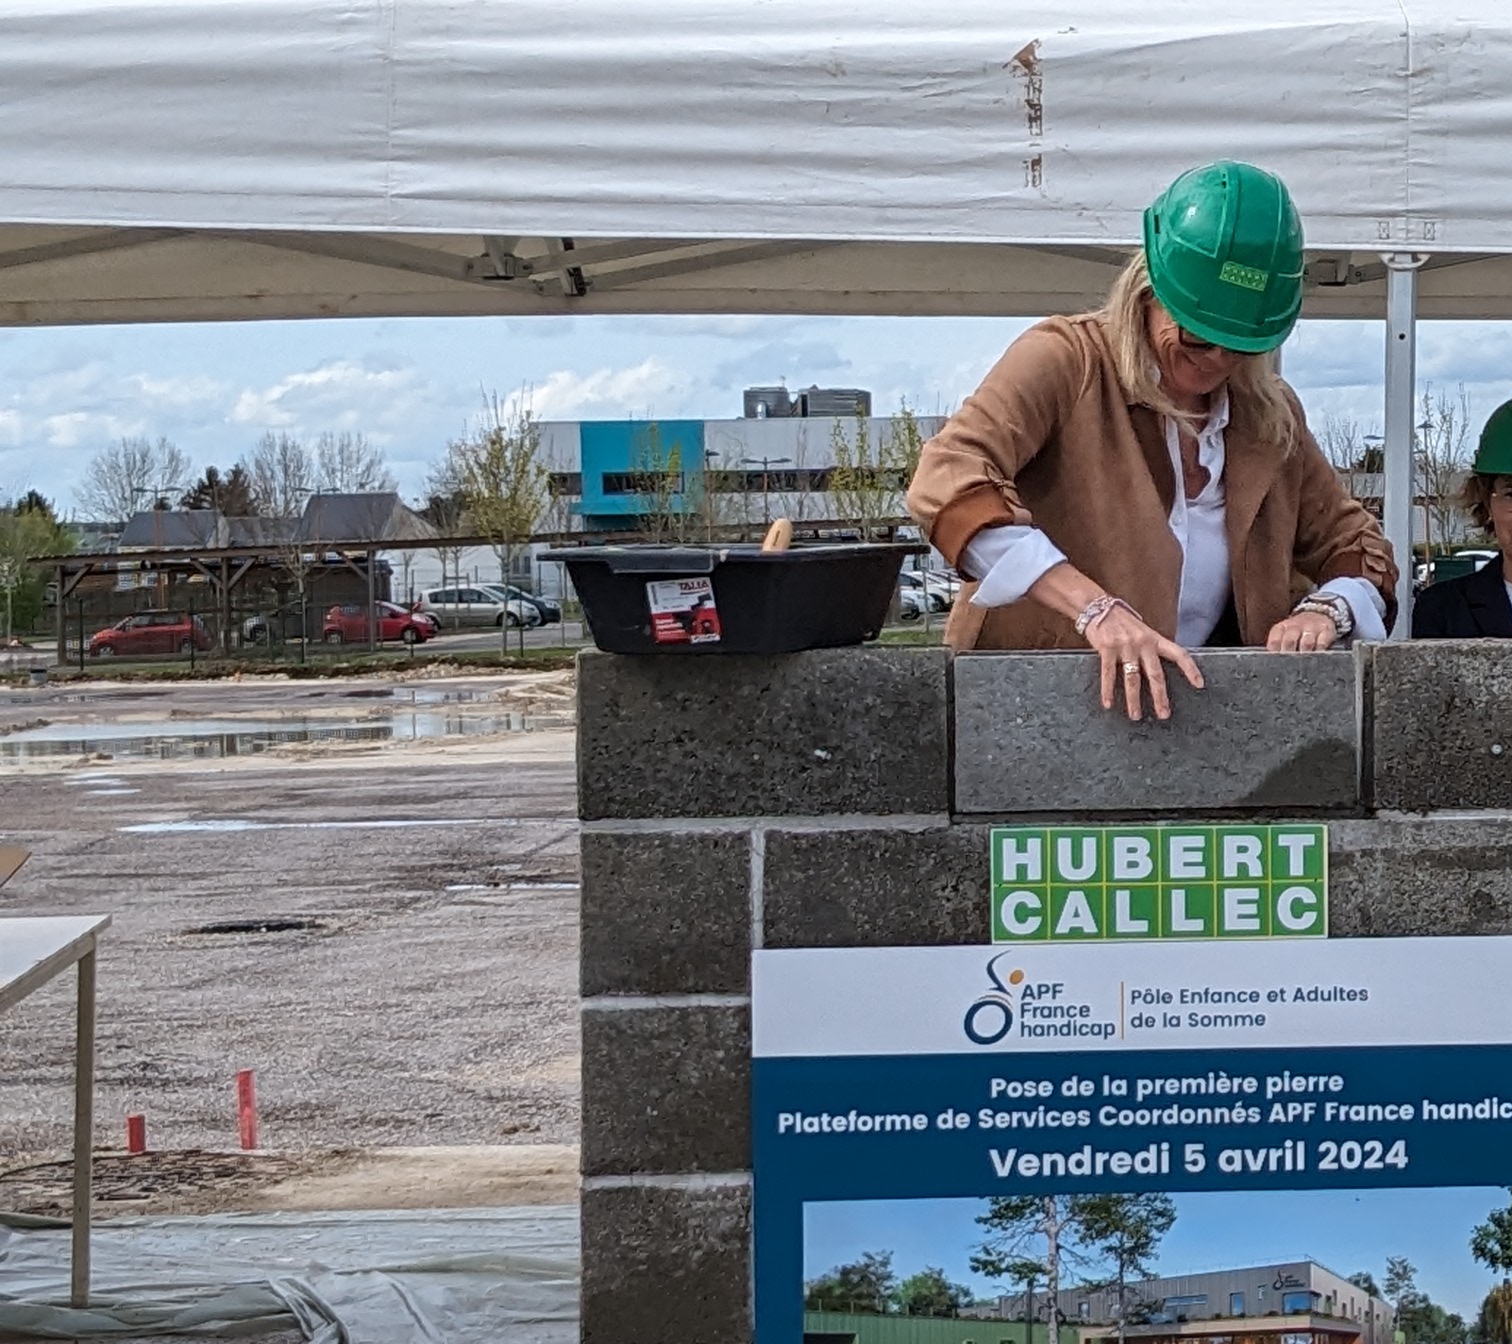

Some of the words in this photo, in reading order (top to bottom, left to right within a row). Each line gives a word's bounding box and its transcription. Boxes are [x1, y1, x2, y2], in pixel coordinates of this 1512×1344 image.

[1002, 834, 1316, 881] HUBERT
[1001, 886, 1318, 935] CALLEC
[1020, 983, 1064, 1001] APF
[1131, 989, 1173, 1005] Pôle
[1180, 987, 1260, 1004] Enfance
[1267, 987, 1287, 1003] et
[1292, 986, 1369, 1002] Adultes
[1020, 1002, 1090, 1019] France
[1131, 1012, 1156, 1028] de
[1163, 1012, 1181, 1028] la
[1188, 1012, 1266, 1027] Somme
[1020, 1020, 1115, 1040] handicap
[991, 1078, 1053, 1098] Pose
[1061, 1076, 1094, 1097] de
[1103, 1075, 1127, 1096] la
[1136, 1071, 1258, 1101] première
[1266, 1070, 1344, 1099] pierre
[778, 1110, 928, 1134] Plateforme
[936, 1109, 970, 1130] de
[978, 1106, 1091, 1128] Services
[1099, 1100, 1261, 1127] Coordonnés
[1268, 1102, 1316, 1123] APF
[1325, 1102, 1414, 1121] France
[989, 1142, 1170, 1177] Vendredi
[1184, 1144, 1206, 1172] 5
[1218, 1139, 1306, 1172] avril
[1317, 1140, 1409, 1170] 2024
